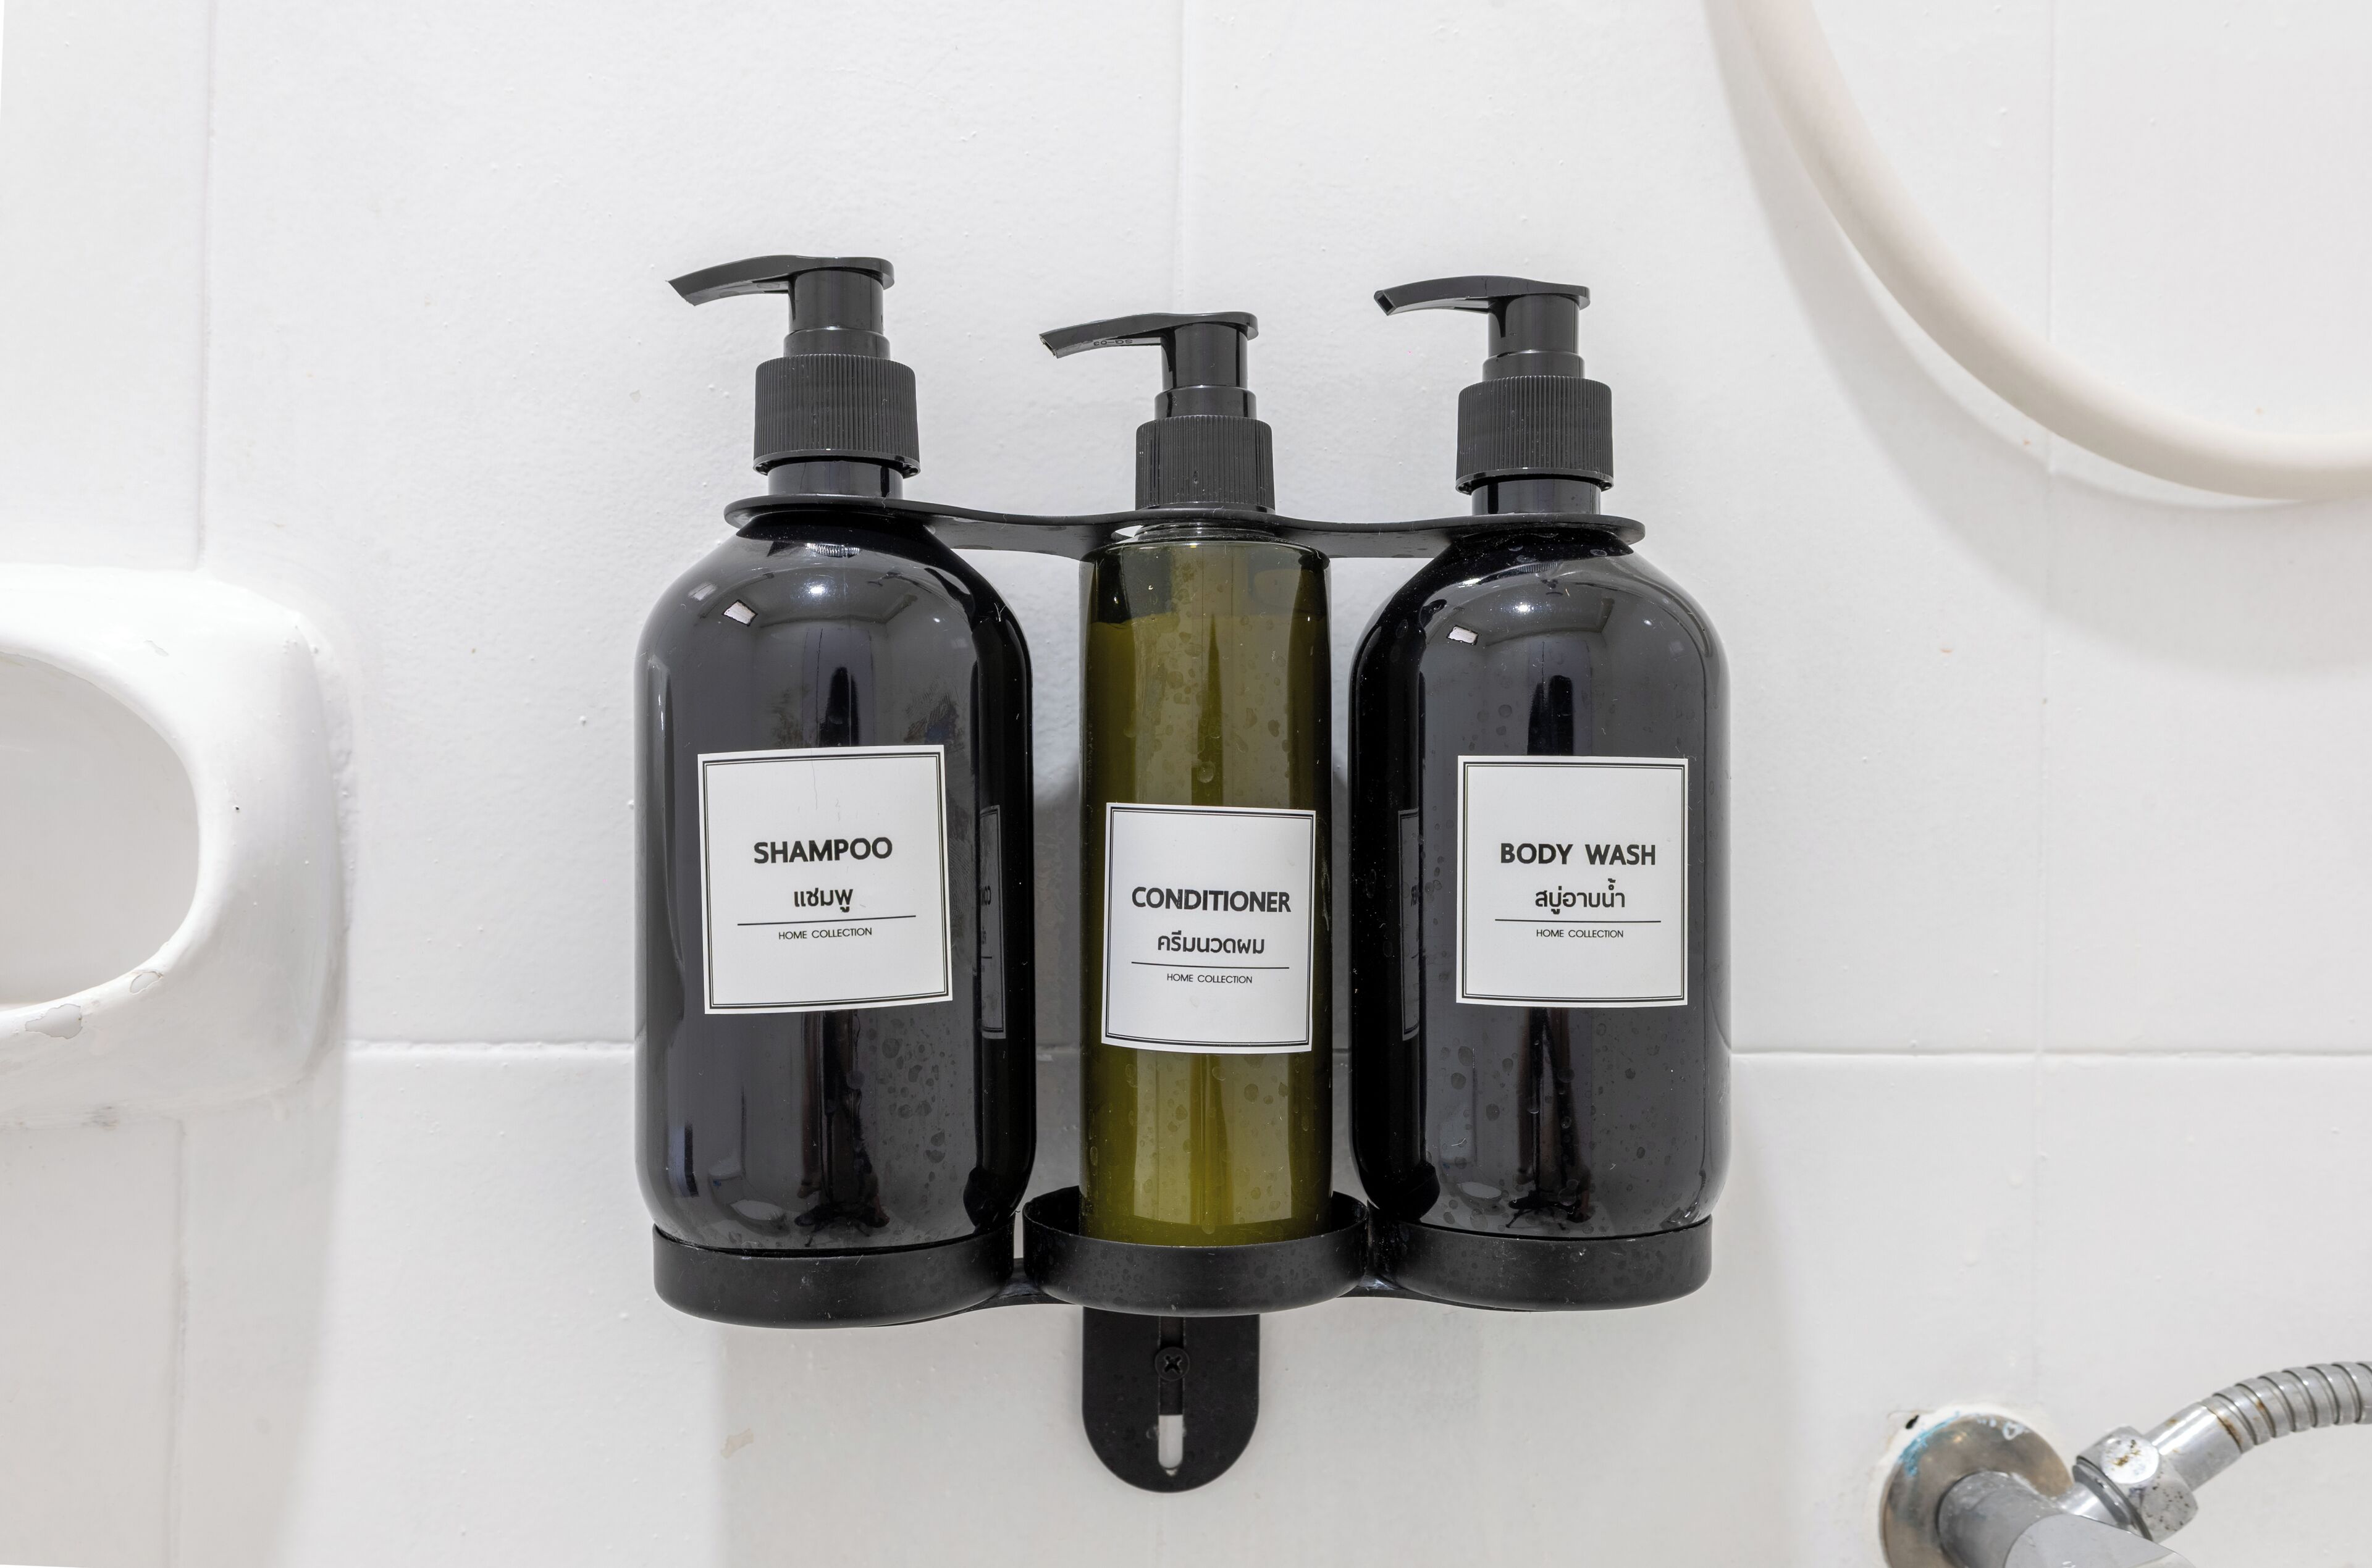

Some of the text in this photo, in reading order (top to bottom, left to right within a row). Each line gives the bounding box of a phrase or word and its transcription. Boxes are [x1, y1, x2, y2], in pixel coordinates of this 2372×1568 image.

[754, 837, 893, 864] SHAMPOO
[1500, 842, 1655, 865] BODY WASH
[794, 887, 854, 913] แชมพู
[1132, 886, 1292, 913] CONDITIONER
[1535, 878, 1625, 915] สบู่อาบน้ำ
[778, 927, 872, 940] HOME COLLECTION
[1158, 930, 1265, 954] ครีมนวดผม
[1536, 929, 1624, 938] HOME COLLECTION
[1167, 973, 1253, 984] HOME COLLECTION
